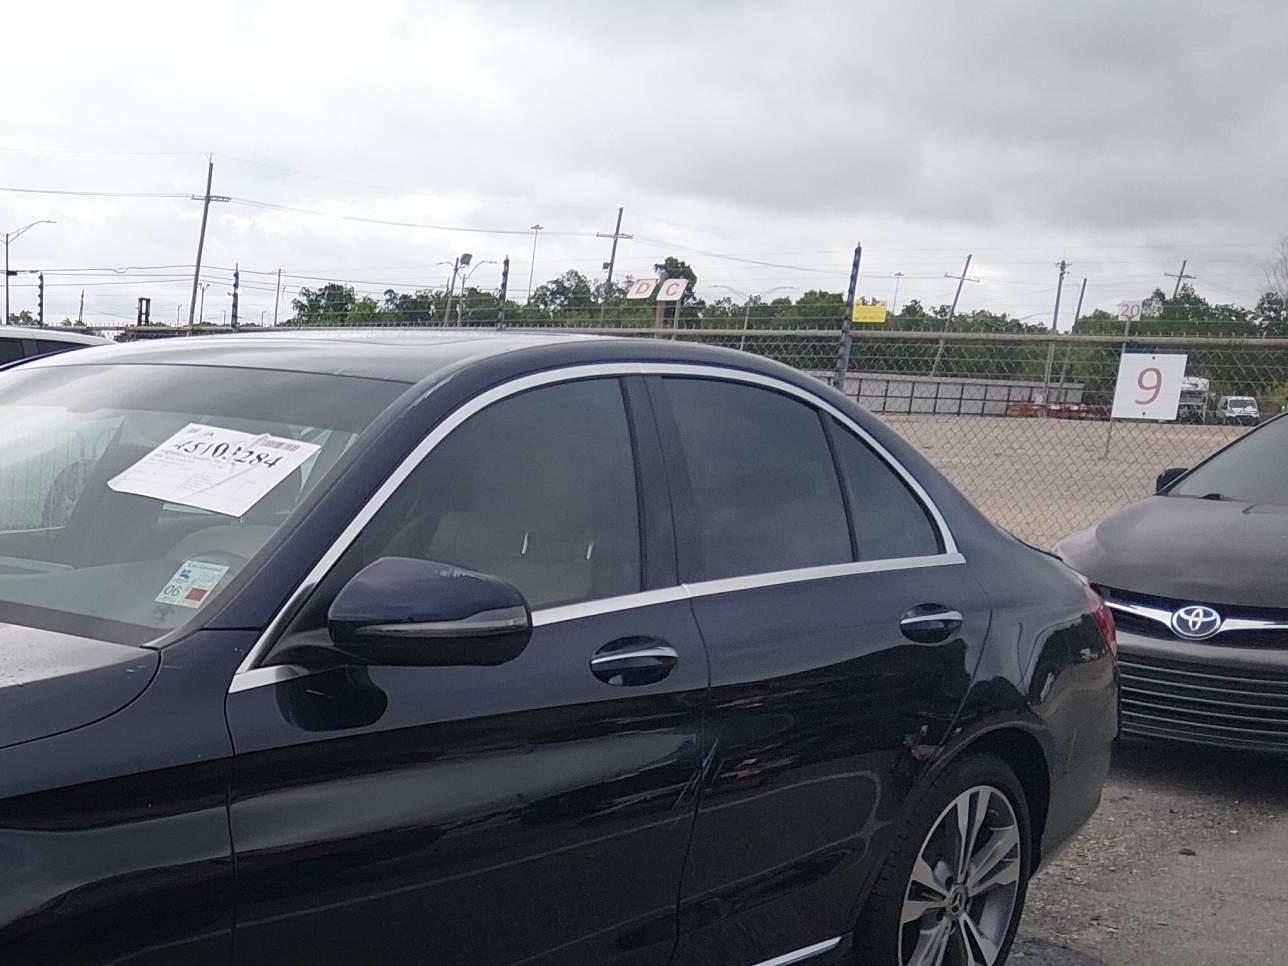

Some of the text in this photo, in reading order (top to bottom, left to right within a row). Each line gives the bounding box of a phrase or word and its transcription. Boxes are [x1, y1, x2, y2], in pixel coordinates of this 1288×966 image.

[635, 282, 650, 295] D
[666, 282, 680, 296] C
[1120, 303, 1140, 317] 20
[1135, 367, 1162, 405] 9
